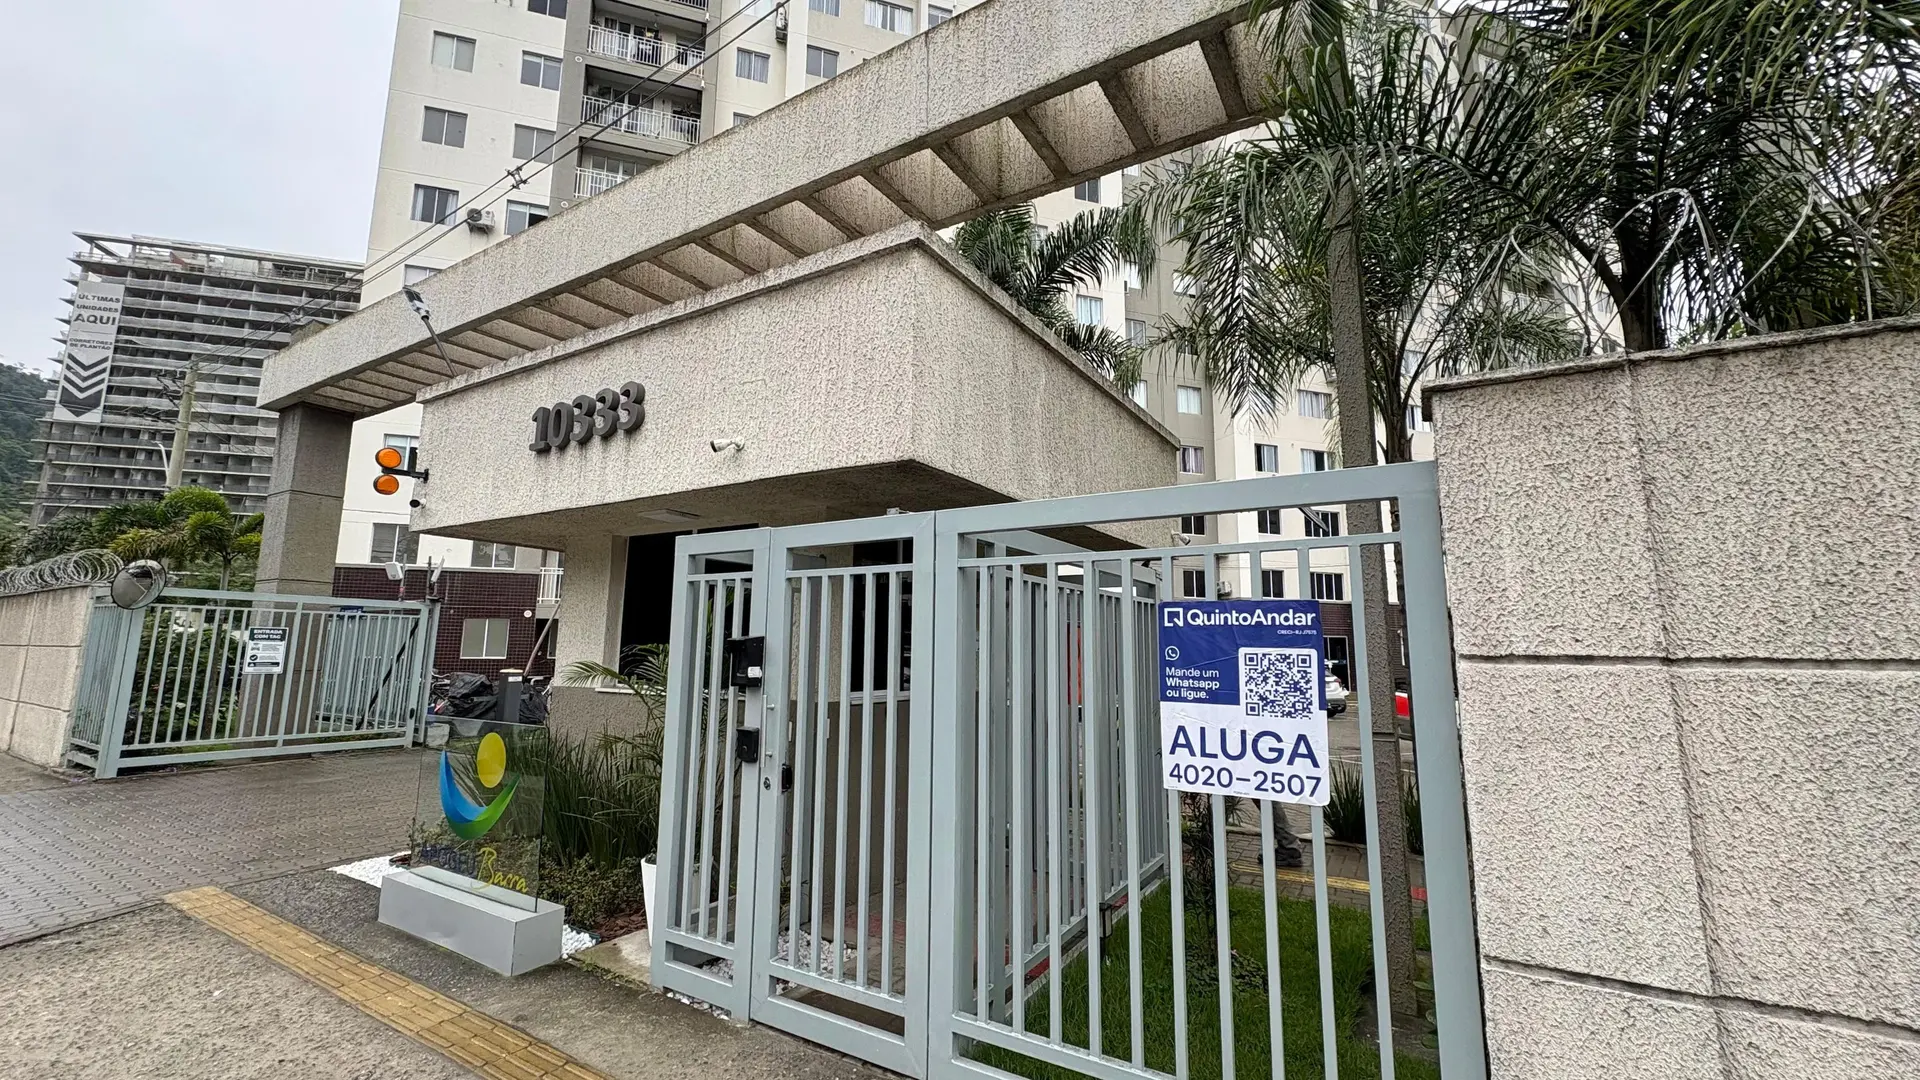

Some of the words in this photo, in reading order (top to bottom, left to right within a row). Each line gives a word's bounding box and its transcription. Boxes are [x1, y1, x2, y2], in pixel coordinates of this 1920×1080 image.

[76, 304, 119, 312] UNIDADES
[73, 314, 116, 325] AQUI
[528, 381, 646, 453] 10333
[1187, 608, 1316, 627] QuintoAndar
[1165, 666, 1200, 677] Mande
[1202, 670, 1219, 678] um
[1165, 677, 1220, 690] Whatsapp
[1166, 689, 1179, 697] ou
[1181, 688, 1209, 700] ligue.
[1169, 725, 1321, 769] ALUGA
[1169, 763, 1322, 799] 4020-2507
[472, 847, 529, 892] Barra
